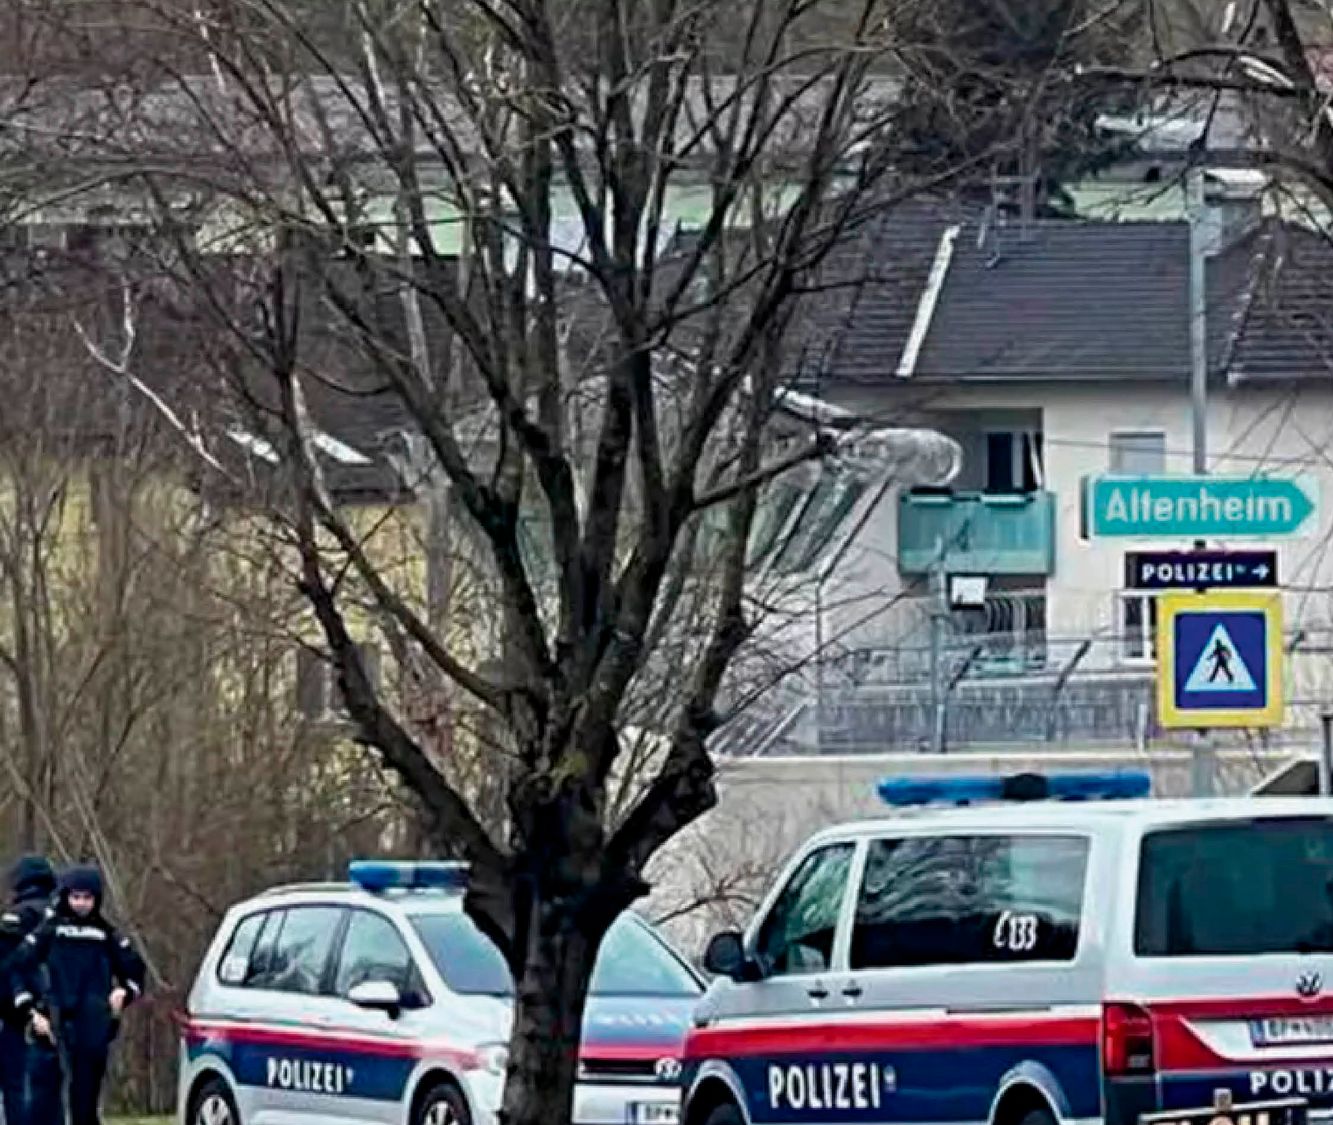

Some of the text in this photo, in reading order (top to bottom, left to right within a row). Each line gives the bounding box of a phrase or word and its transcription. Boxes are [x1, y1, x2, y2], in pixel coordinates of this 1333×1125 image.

[1105, 487, 1292, 522] Altenheim
[1141, 563, 1232, 583] POLIZEI
[267, 1057, 343, 1092] POLIZEI
[768, 1062, 880, 1109] POLIZEI
